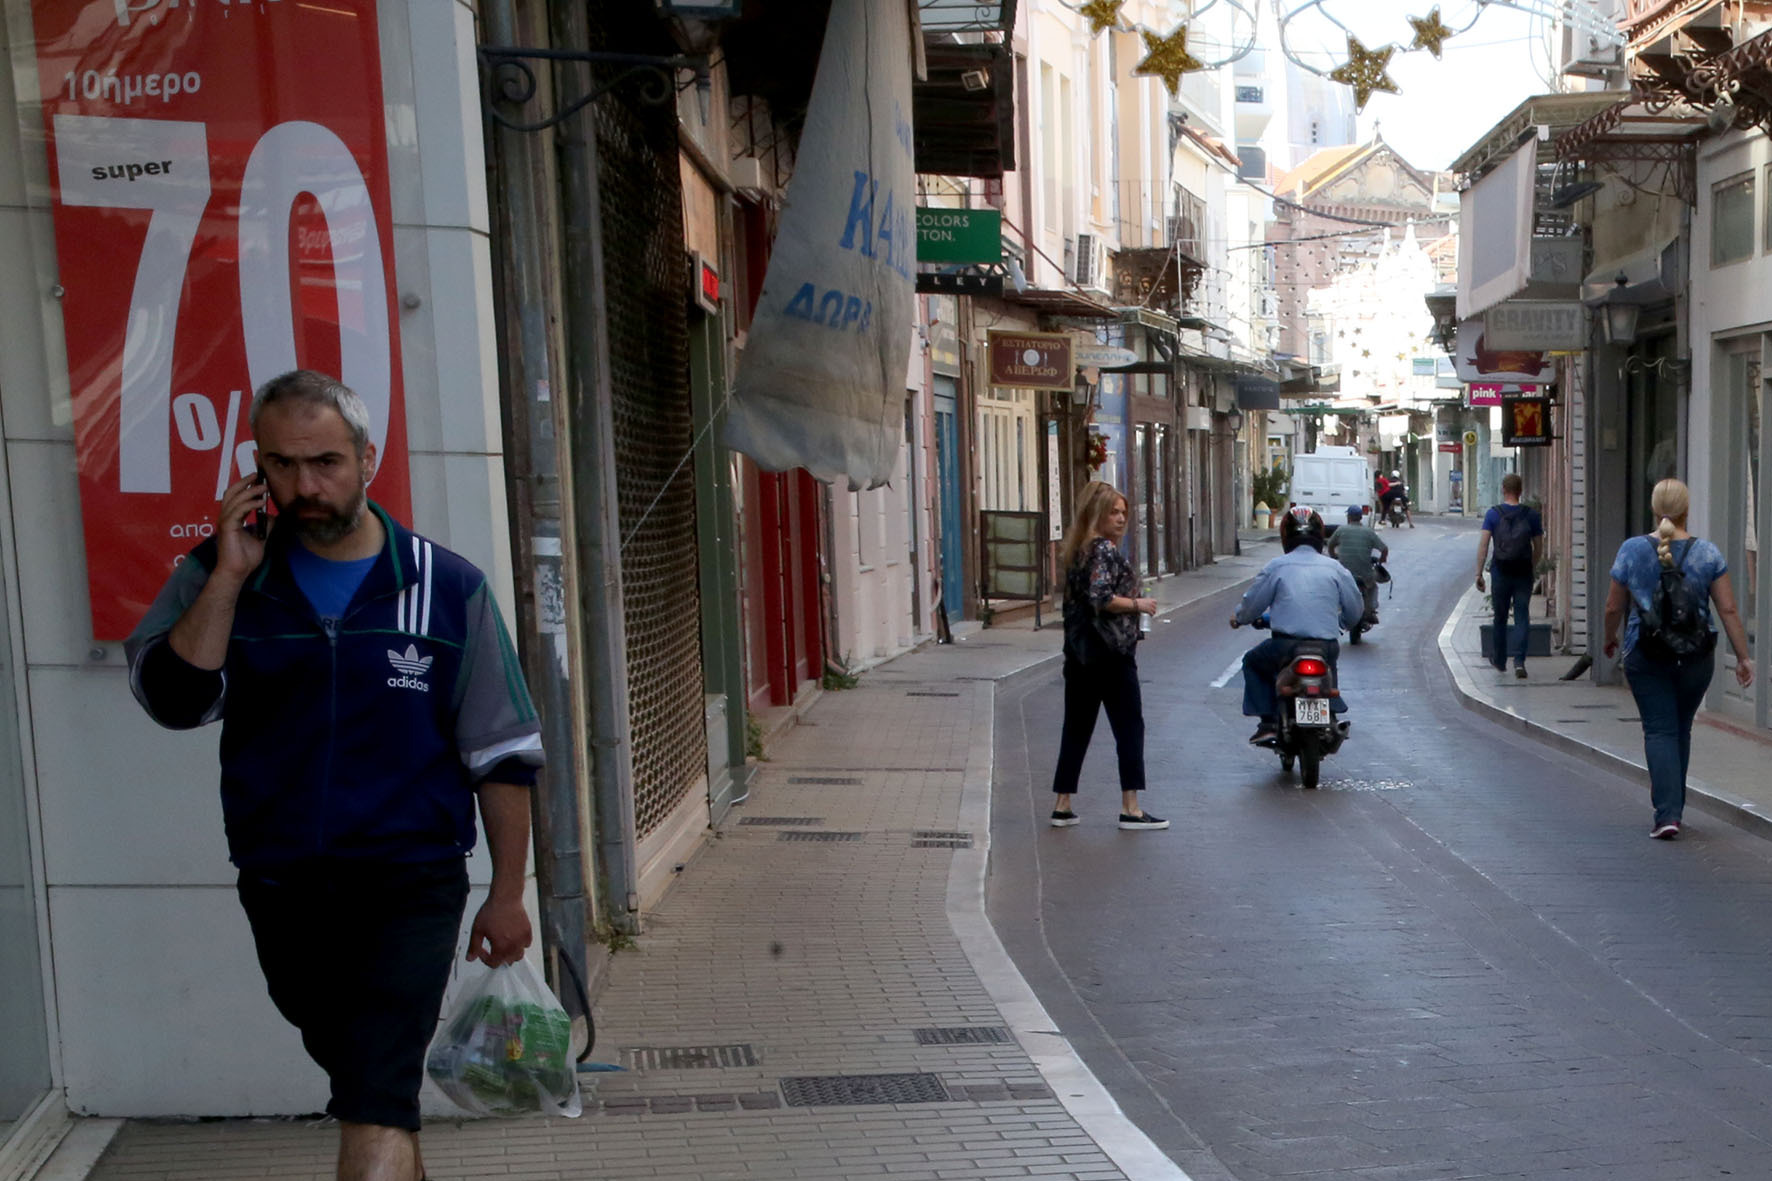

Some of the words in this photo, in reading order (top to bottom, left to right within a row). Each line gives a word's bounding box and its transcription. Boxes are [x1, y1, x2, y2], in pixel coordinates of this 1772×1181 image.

[63, 68, 202, 105] 10ήμερο
[91, 157, 173, 182] super
[917, 229, 956, 242] TON.
[1494, 309, 1578, 331] GRAVITY
[1472, 387, 1496, 399] pink
[169, 515, 214, 537] από
[386, 676, 431, 693] adidas
[1300, 711, 1320, 722] 768
